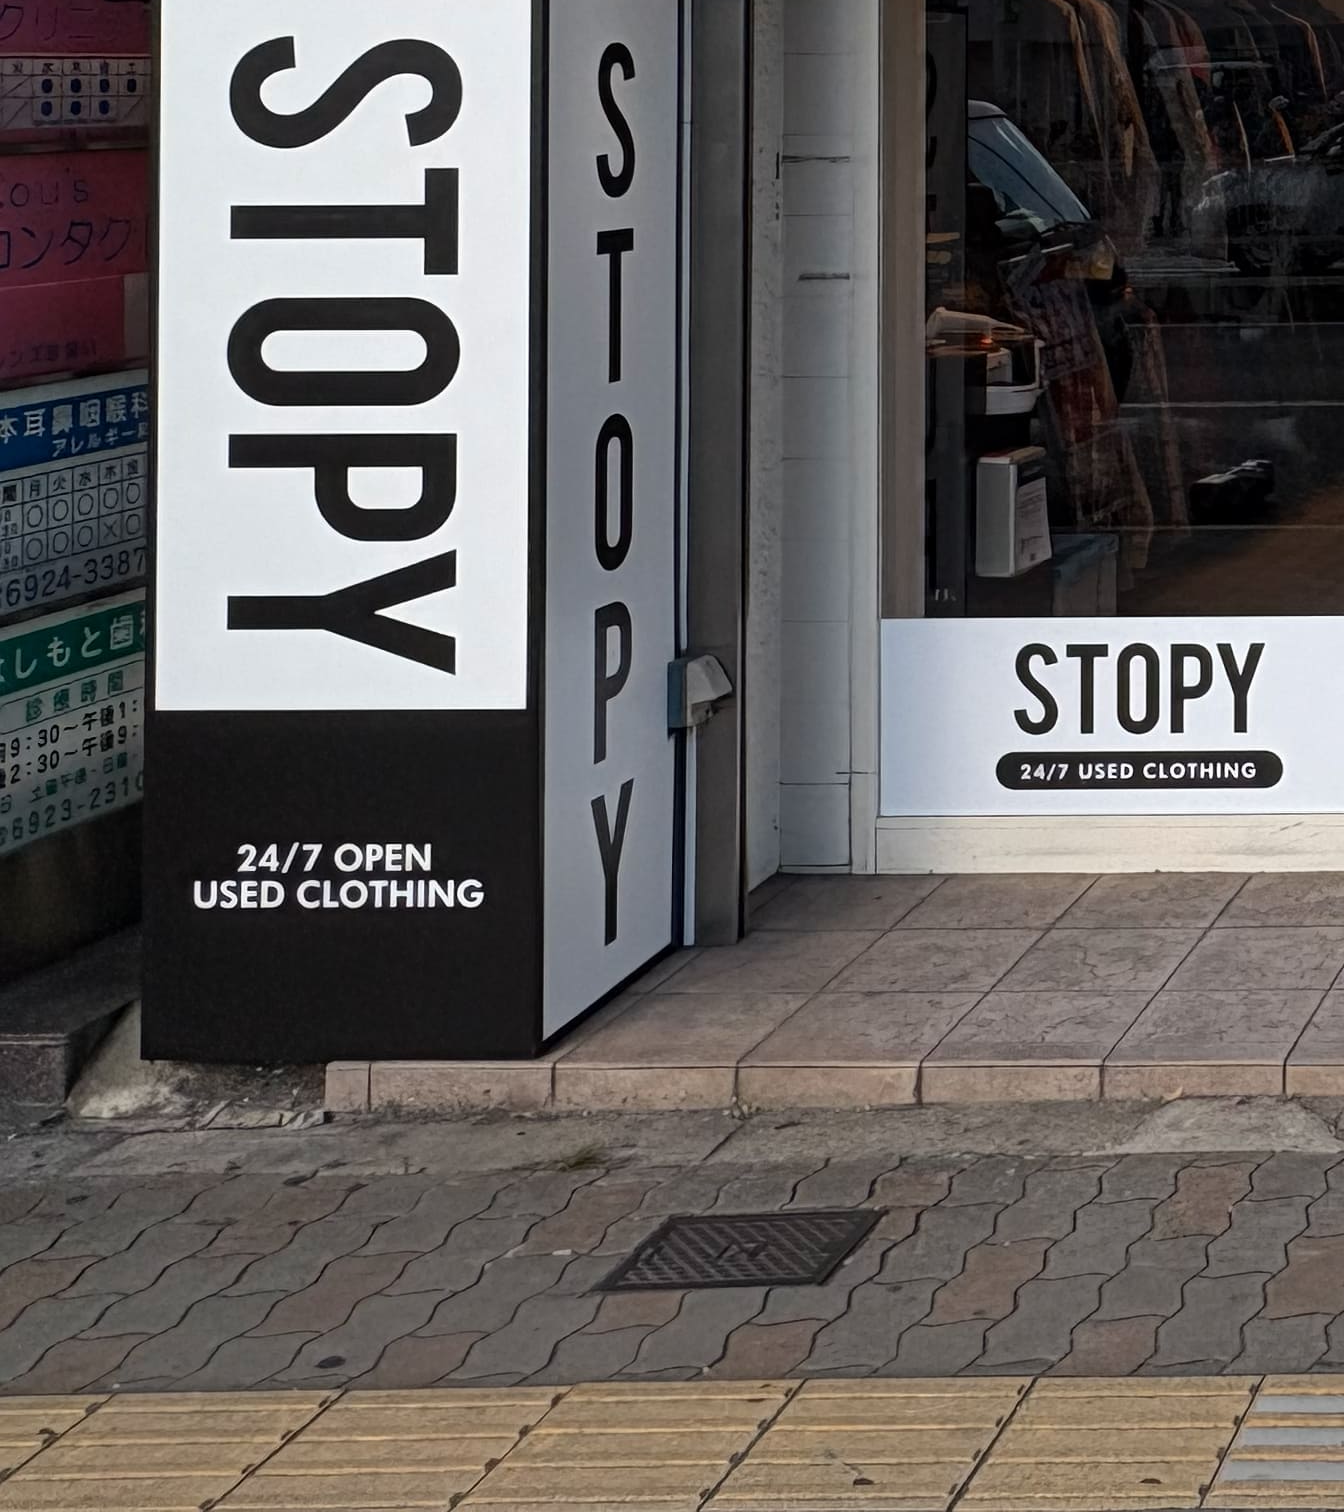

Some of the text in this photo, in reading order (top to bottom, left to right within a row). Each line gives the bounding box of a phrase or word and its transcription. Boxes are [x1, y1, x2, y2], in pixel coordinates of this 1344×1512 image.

[0, 217, 149, 269] ンタク
[226, 35, 463, 676] STOPY
[590, 42, 635, 947] STOPY
[0, 608, 145, 681] しもと歯
[1013, 642, 1266, 736] STOPY
[1019, 758, 1258, 782] 24/7 USED CLOTHING
[237, 842, 432, 874] 24/7 OPEN
[193, 879, 485, 909] USED CLOTHING
